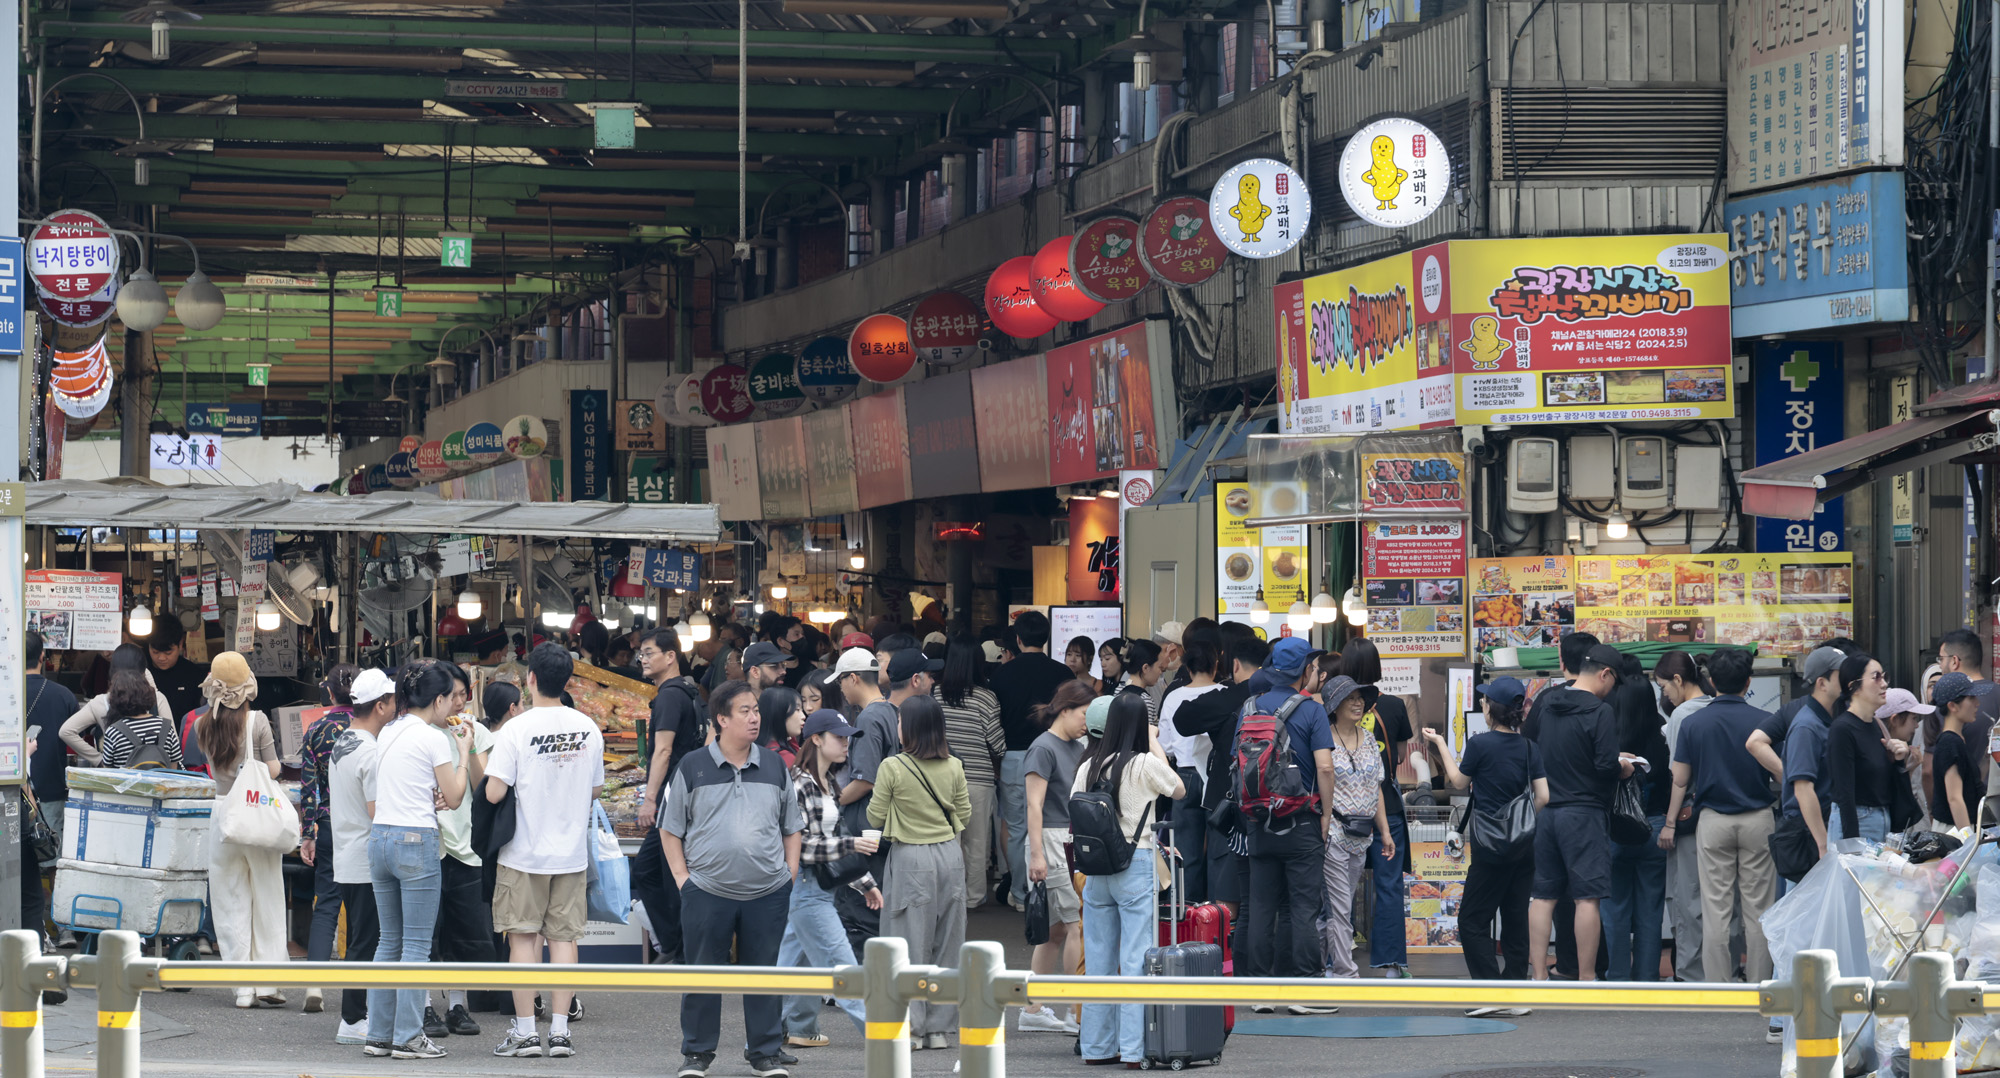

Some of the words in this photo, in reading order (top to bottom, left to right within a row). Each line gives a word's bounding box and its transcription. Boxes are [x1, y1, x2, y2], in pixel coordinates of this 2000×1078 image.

[466, 85, 495, 95] CCTV
[496, 84, 529, 97] 24시간
[530, 85, 559, 97] 녹화중
[1778, 66, 1787, 177] 명동의상실
[1412, 168, 1427, 207] 꽈배기
[1276, 205, 1290, 240] 꽈배기
[1153, 239, 1202, 264] 순희네
[1676, 247, 1707, 256] 광장시장
[1729, 201, 1833, 287] 동문직물부
[35, 245, 110, 268] 낙지탕탕이
[1668, 258, 1691, 268] 최고의
[1694, 257, 1717, 268] 꽈배기
[1082, 255, 1129, 279] 순희네
[1178, 257, 1216, 274] 육회
[56, 278, 92, 292] 전문
[1105, 276, 1140, 291] 육회
[1516, 267, 1661, 295] 광장시장
[60, 303, 93, 317] 전문
[913, 314, 979, 339] 동관주단부
[1550, 329, 1636, 340] 채널A관찰카메라24
[1638, 327, 1688, 338] (2018.3.9)
[859, 341, 910, 356] 일호상회
[1551, 341, 1575, 351] tvN
[1636, 339, 1688, 350] (2024.2.5)
[710, 375, 748, 393] 广场
[713, 394, 750, 413] 人参
[1342, 404, 1352, 425] tvN
[1500, 413, 1530, 423] 종로5가
[1532, 412, 1562, 422] 9번출구
[1563, 411, 1596, 421] 광장시장
[1598, 411, 1628, 420] 북2문앞
[1631, 409, 1691, 419] 010.9498.3115
[466, 434, 503, 449] 성미식품
[583, 411, 596, 496] MG새마을금고
[1376, 459, 1450, 481] 광장시장
[1785, 401, 1815, 552] 정치원
[1421, 524, 1459, 536] 1,500원
[1821, 535, 1837, 546] 3F
[630, 559, 643, 570] 27
[1523, 564, 1541, 573] tvN
[652, 568, 693, 587] 견과류
[57, 600, 75, 608] 2,000
[269, 639, 289, 649] 종이컵
[1415, 635, 1439, 643] 광장시장
[1390, 644, 1441, 652] 010.9498.3115
[530, 732, 591, 746] NASTY
[537, 741, 584, 755] KICK
[1424, 850, 1441, 859] tvN
